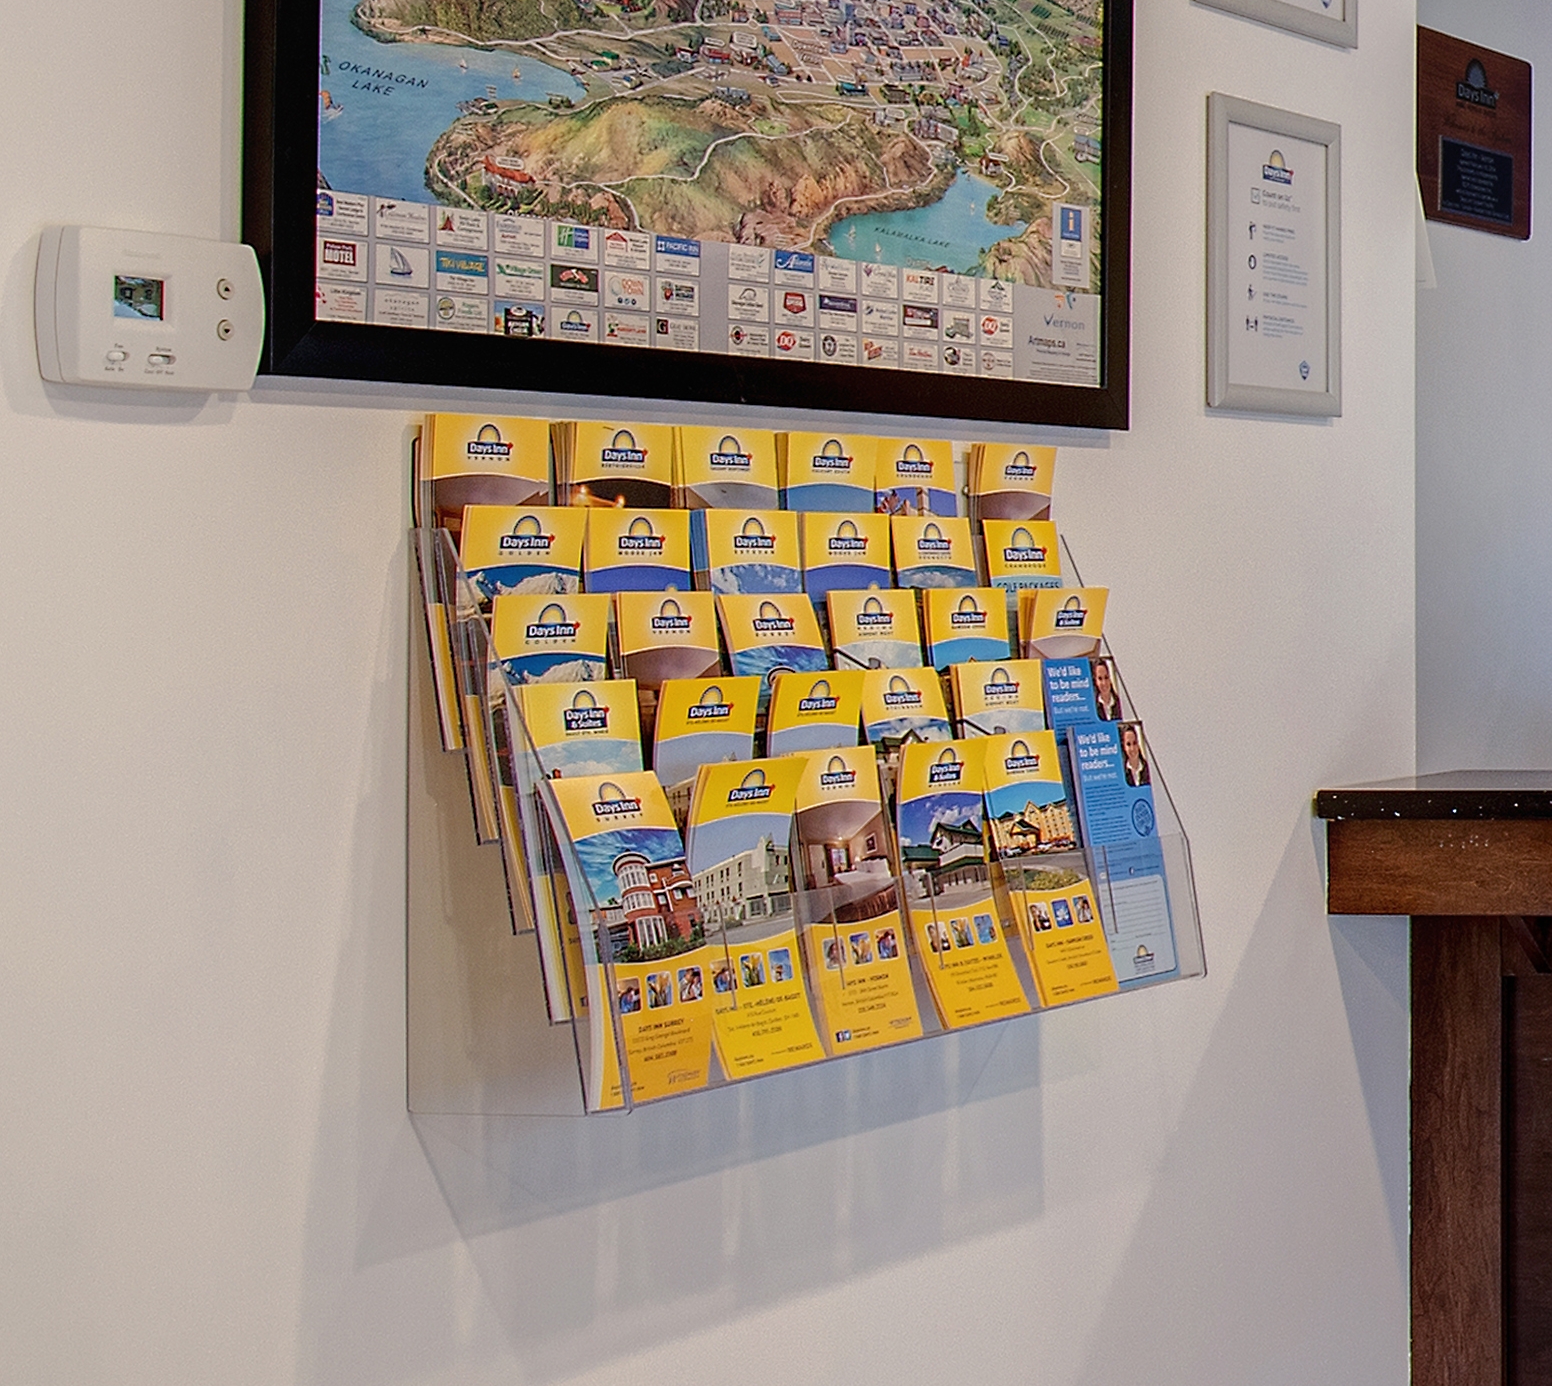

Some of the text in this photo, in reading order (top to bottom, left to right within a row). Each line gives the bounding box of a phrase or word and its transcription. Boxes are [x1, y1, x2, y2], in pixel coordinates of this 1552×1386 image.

[339, 61, 429, 90] OKANAGAN
[352, 80, 396, 97] LAKE
[1457, 82, 1494, 107] Days Inn
[324, 249, 354, 264] MOTEL
[1044, 314, 1085, 331] Vernon
[470, 443, 508, 455] Days Inn
[604, 450, 643, 461] Days Inn
[712, 455, 748, 465] Days Inn
[815, 458, 849, 468] Days Inn
[898, 463, 916, 472] Days
[503, 537, 548, 548] Days Inn
[621, 538, 661, 548] Days Inn
[736, 537, 772, 548] Days Inn
[831, 540, 851, 550] Days
[1006, 549, 1043, 561] Days Inn
[654, 618, 673, 628] Days
[755, 620, 791, 631] Days Inn
[529, 626, 574, 637] Days Inn
[1048, 667, 1081, 677] We'd like
[1051, 678, 1089, 689] to be mind
[1052, 693, 1086, 703] readers...
[690, 705, 728, 717] Days Inn
[566, 712, 589, 722] Days
[579, 720, 601, 728] Suites
[1078, 733, 1110, 744] We'd like
[1090, 747, 1099, 756] be
[1101, 744, 1117, 755] mind
[1082, 760, 1114, 770] readers...
[822, 774, 854, 784] Days Inn
[730, 788, 770, 800] Days Inn
[594, 801, 638, 815] Days Inn
[596, 814, 643, 822] SURREY
